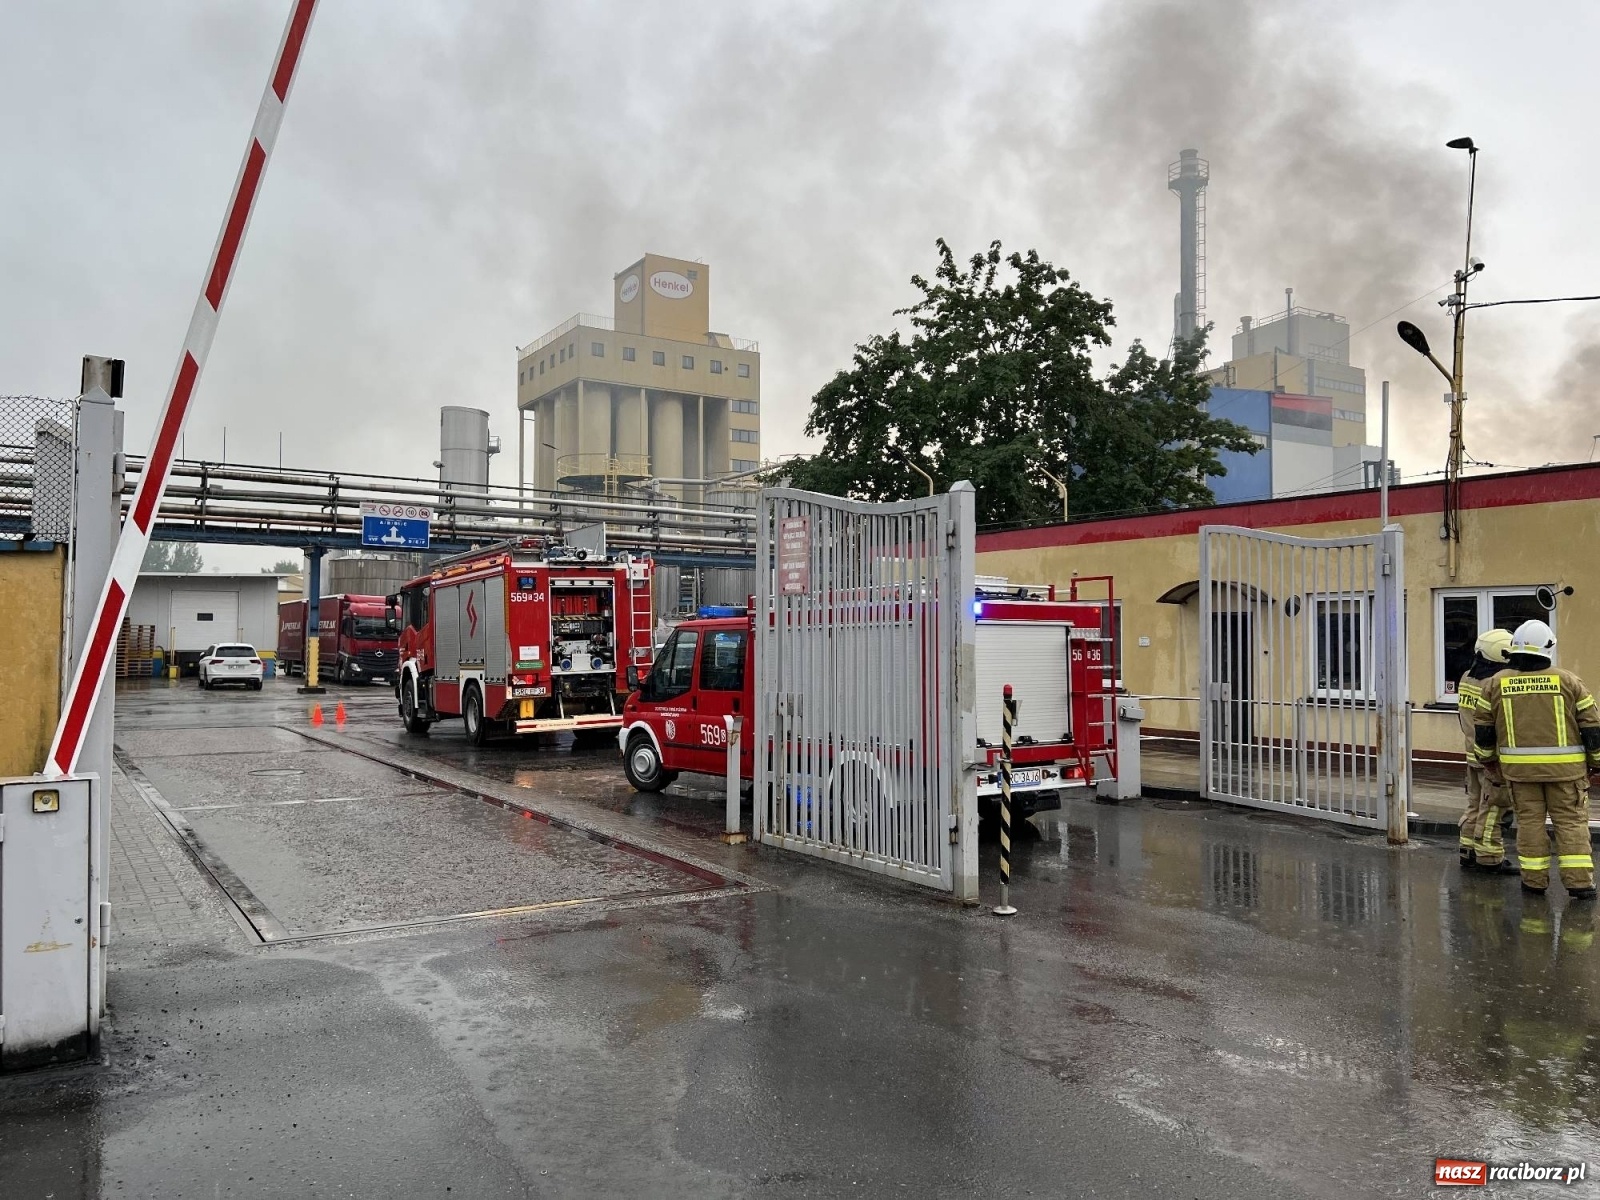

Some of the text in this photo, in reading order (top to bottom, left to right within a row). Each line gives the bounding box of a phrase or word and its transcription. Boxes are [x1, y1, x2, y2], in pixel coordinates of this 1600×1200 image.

[654, 277, 689, 292] Henkel
[1509, 677, 1551, 685] OCHOTNICZA
[1021, 771, 1039, 783] 3AJ6
